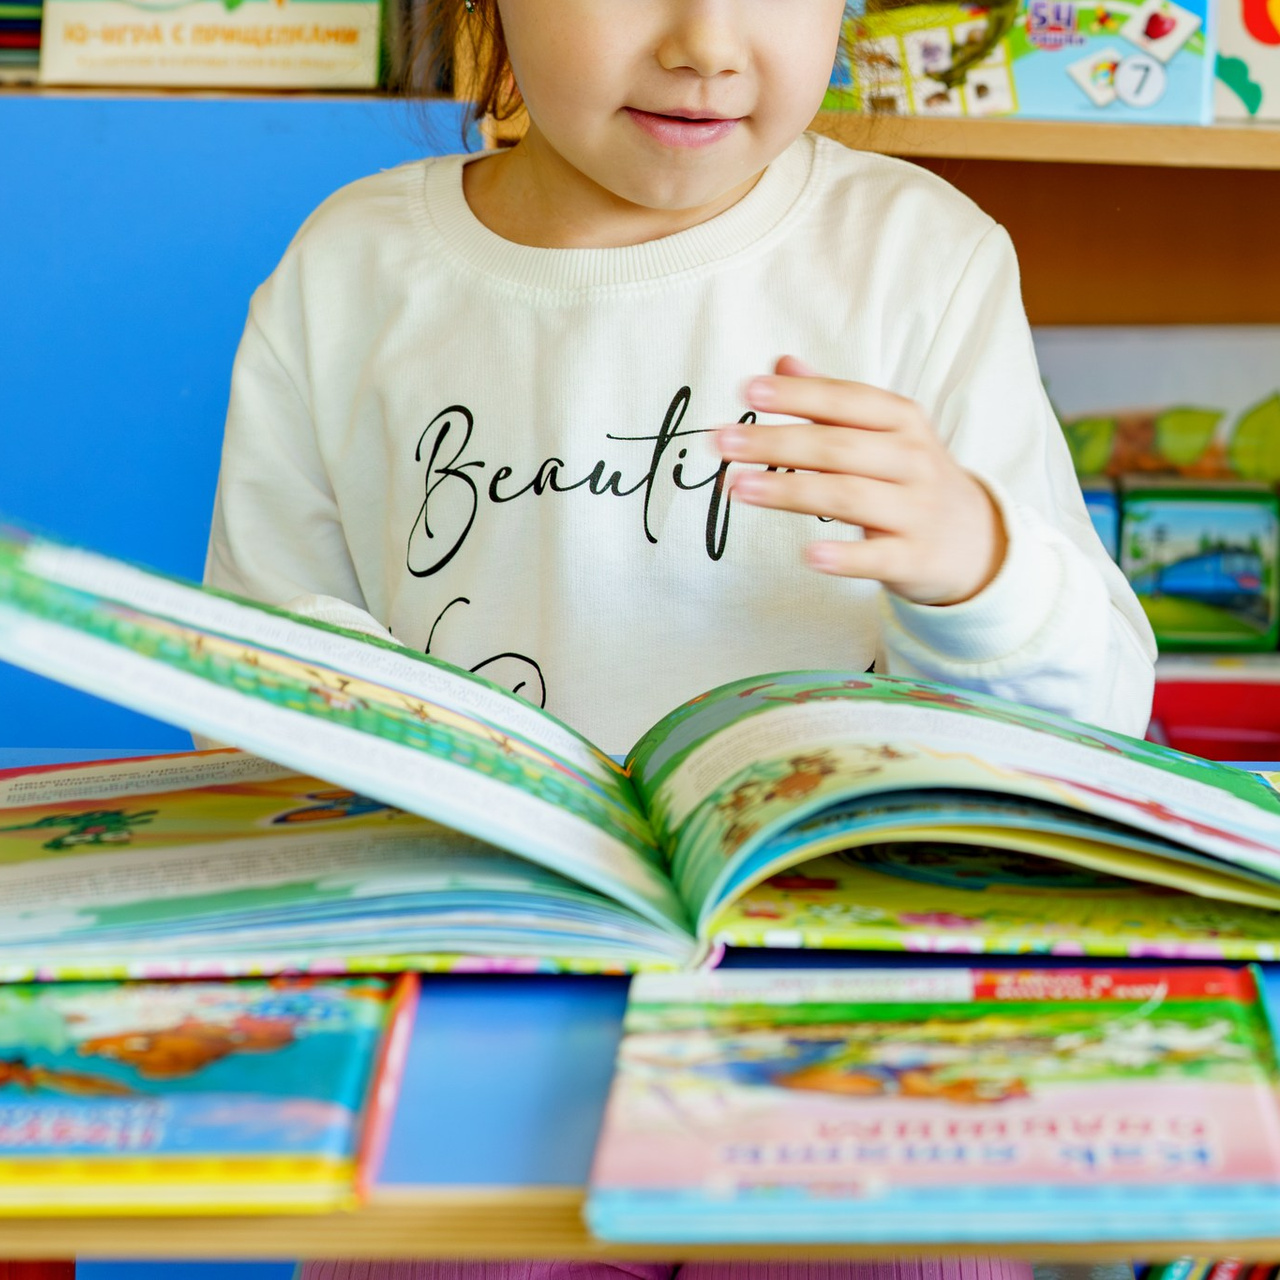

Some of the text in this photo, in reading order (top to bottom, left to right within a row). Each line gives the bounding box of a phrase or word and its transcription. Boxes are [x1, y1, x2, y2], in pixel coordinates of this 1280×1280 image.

[1033, 1, 1073, 27] 54
[1130, 64, 1152, 98] 7
[406, 385, 836, 578] Beautif
